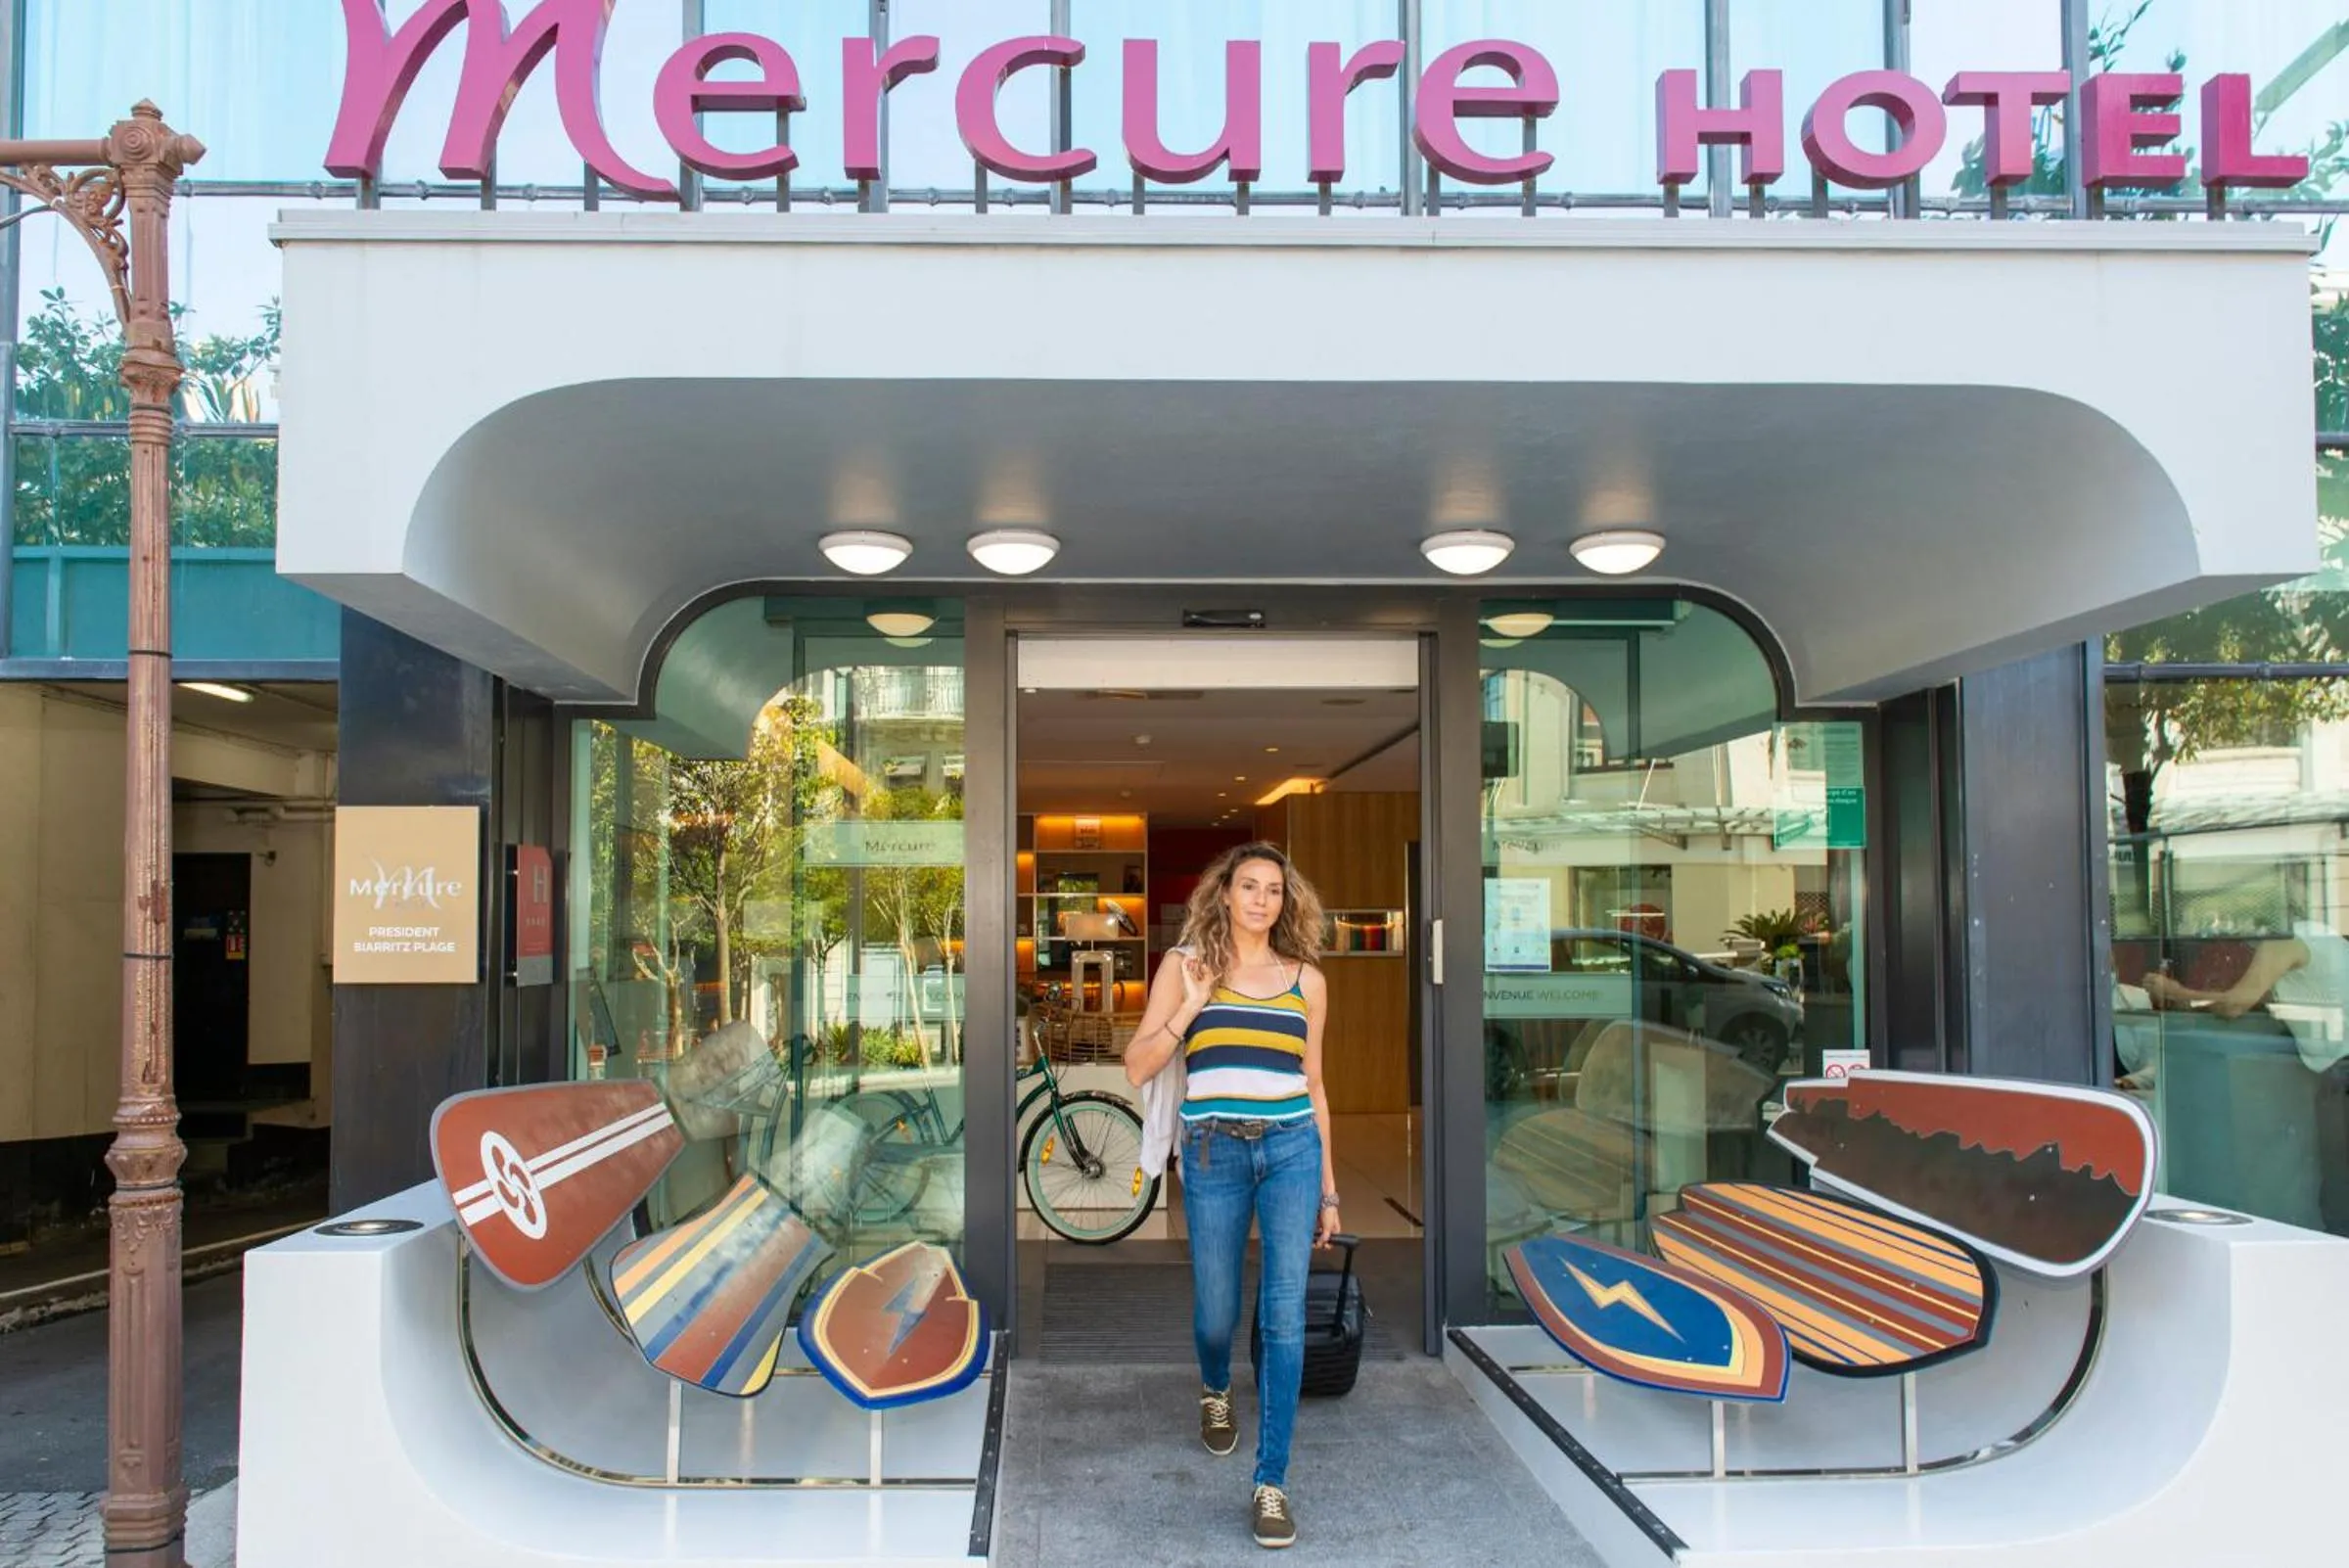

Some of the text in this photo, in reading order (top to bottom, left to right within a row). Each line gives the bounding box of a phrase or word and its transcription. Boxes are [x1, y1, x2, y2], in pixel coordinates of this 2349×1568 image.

[324, 0, 2309, 203] Mercure HOTEL
[368, 926, 440, 938] PRESIDENT
[352, 941, 456, 953] BIARRITZ PLAGE
